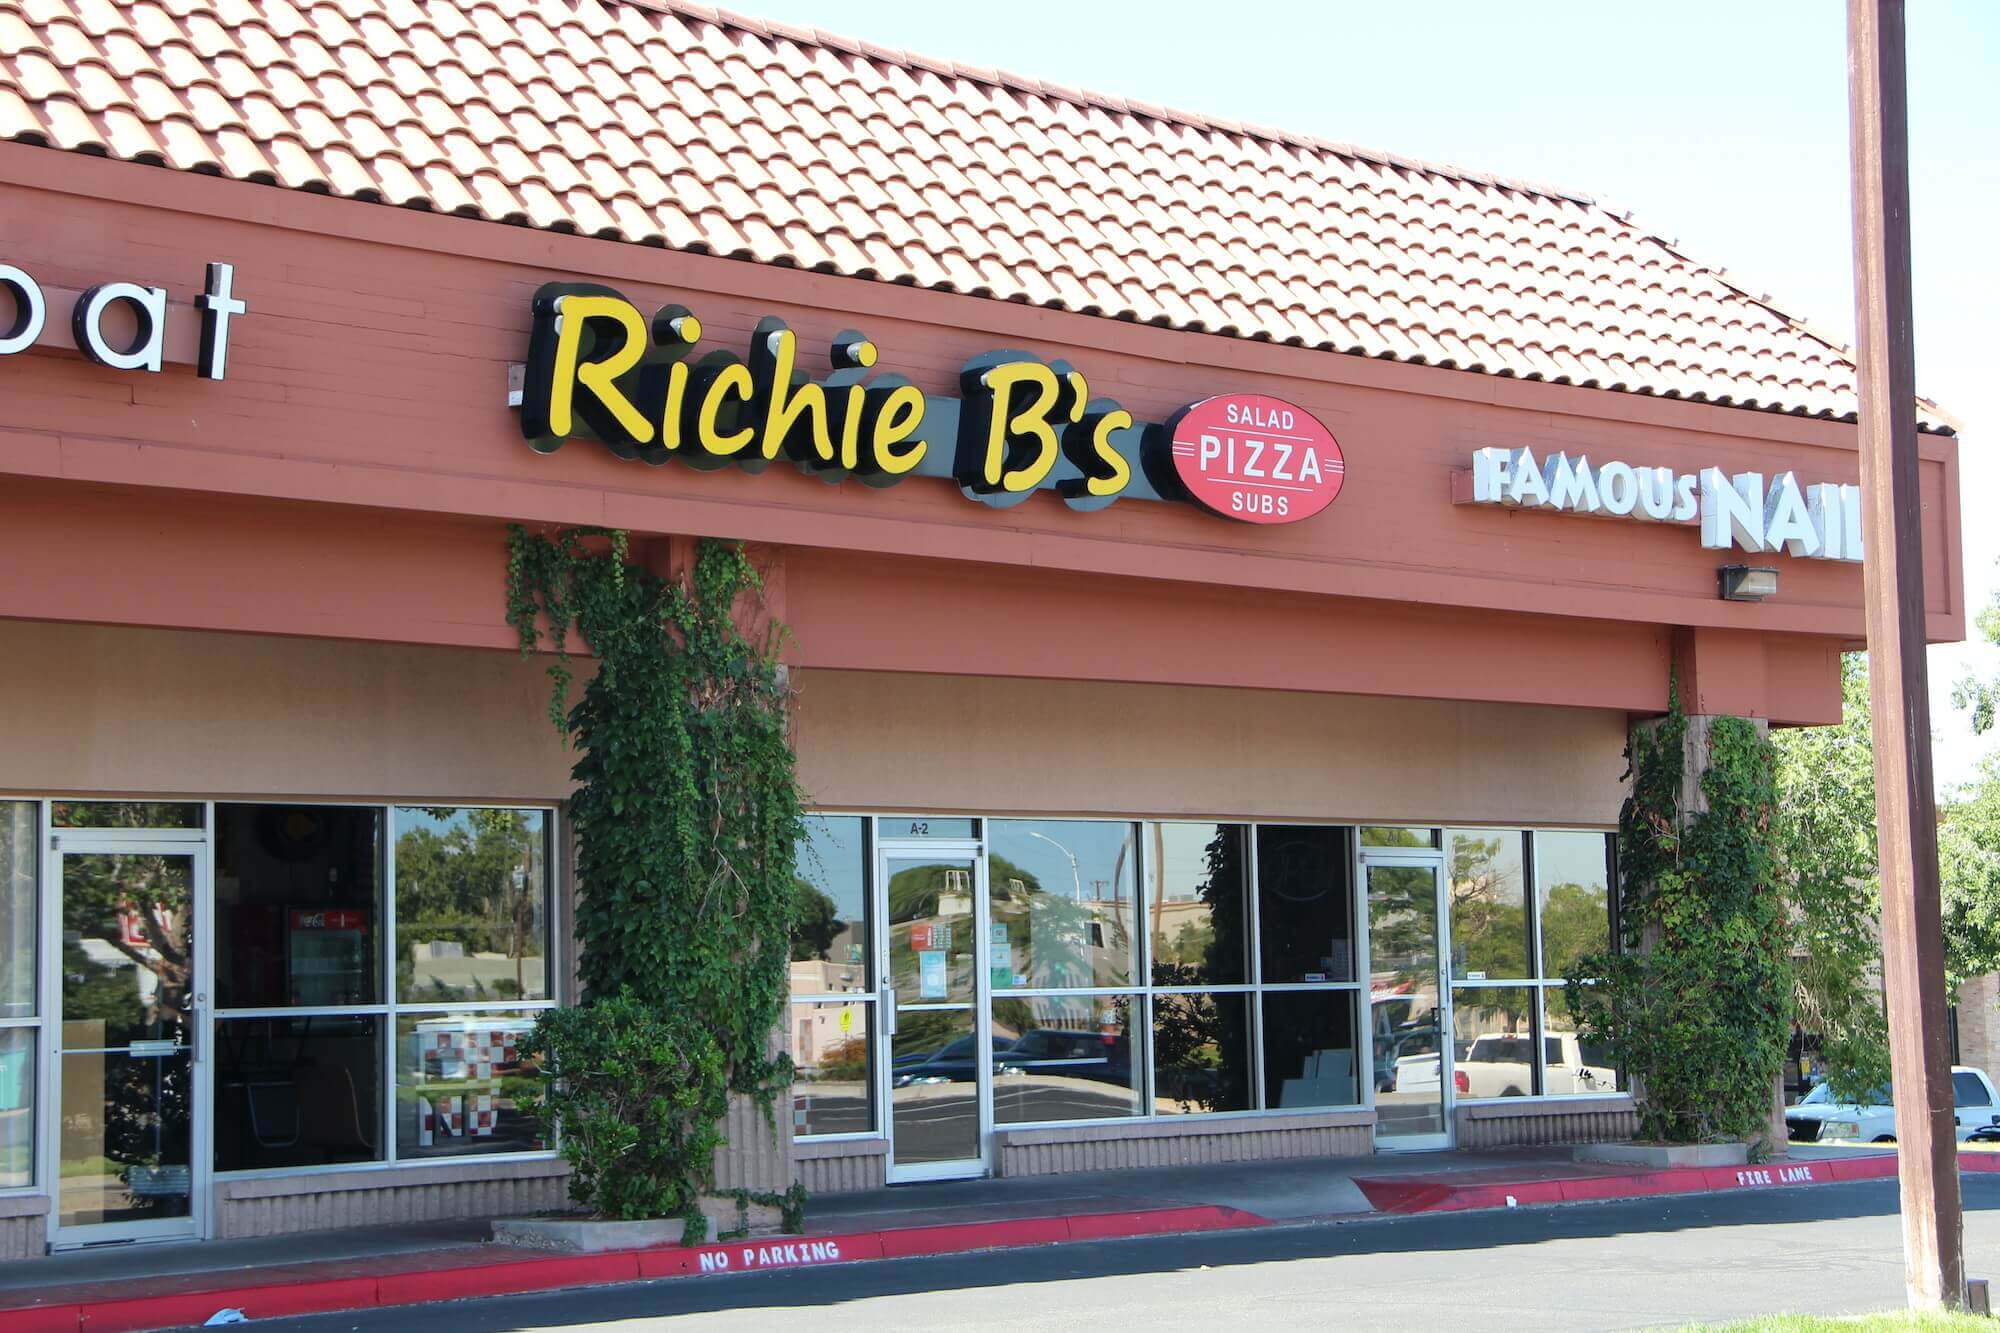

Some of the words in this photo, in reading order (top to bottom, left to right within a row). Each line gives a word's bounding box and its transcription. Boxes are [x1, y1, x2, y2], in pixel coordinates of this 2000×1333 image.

[548, 295, 929, 475] Richie
[983, 361, 1134, 496] B's
[1227, 404, 1294, 430] SALAD
[1200, 435, 1322, 484] PIZZA
[1474, 446, 1698, 521] FAMOUS
[1232, 492, 1289, 516] SUBS
[910, 822, 929, 835] A-2
[1736, 1170, 1772, 1186] FIRE
[1778, 1166, 1813, 1183] LANE
[699, 1251, 729, 1272] NO
[743, 1241, 840, 1266] PARKING
